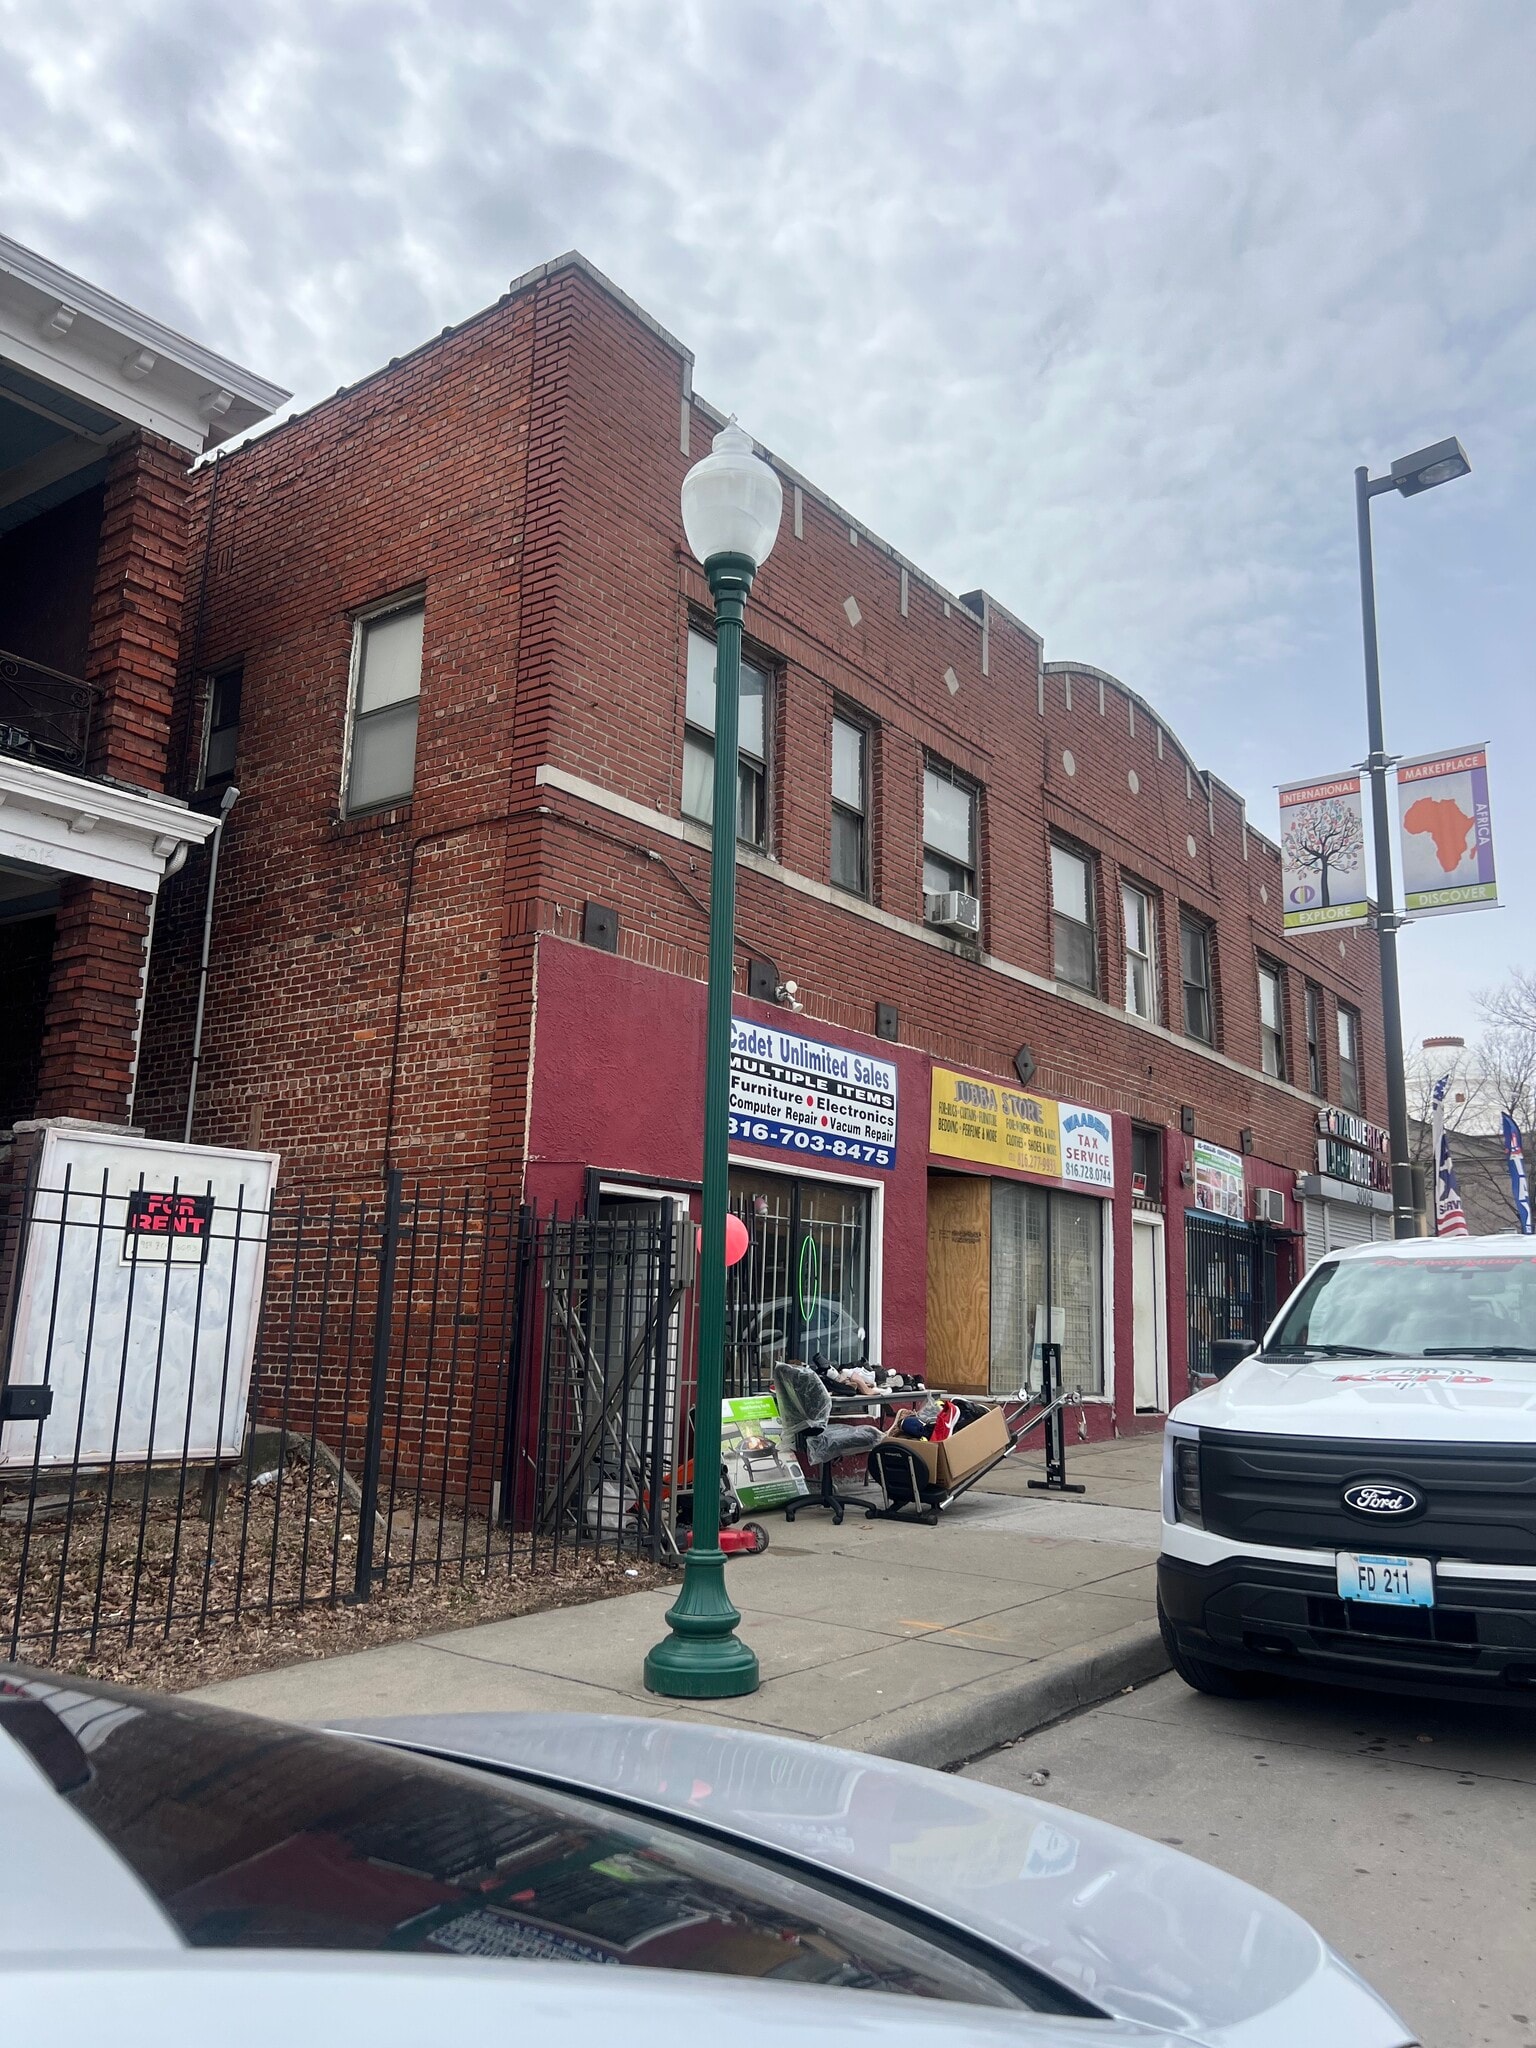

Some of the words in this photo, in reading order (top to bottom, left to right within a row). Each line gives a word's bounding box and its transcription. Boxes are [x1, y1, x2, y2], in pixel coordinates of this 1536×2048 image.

[1405, 757, 1478, 780] MARKETPLACE
[1283, 782, 1354, 804] INTERNATIONAL
[1475, 803, 1491, 846] AFRICA
[1419, 886, 1486, 906] DISCOVER
[1300, 905, 1351, 924] EXPLORE
[730, 1023, 772, 1058] Cadet
[780, 1037, 848, 1079] Unlimited
[854, 1059, 889, 1090] Sales
[730, 1057, 828, 1091] MULTIPLE
[837, 1082, 893, 1107] ITEMS
[731, 1076, 803, 1105] Furniture
[817, 1097, 894, 1126] Electronics
[954, 1080, 998, 1112] JUBBA
[1001, 1092, 1044, 1124] STORE
[730, 1095, 781, 1117] Computer
[786, 1107, 818, 1125] Repair
[830, 1117, 861, 1136] Vacum
[865, 1126, 893, 1143] Repair
[1078, 1134, 1098, 1149] TAX
[1336, 1111, 1381, 1151] TAQUERIA
[1066, 1147, 1110, 1167] SERVICE
[148, 1195, 196, 1216] FOR
[132, 1214, 205, 1234] RENT
[1332, 1373, 1494, 1384] KCFD
[1356, 1488, 1404, 1509] Ford
[1358, 1566, 1375, 1591] FD
[1384, 1568, 1409, 1594] 211
